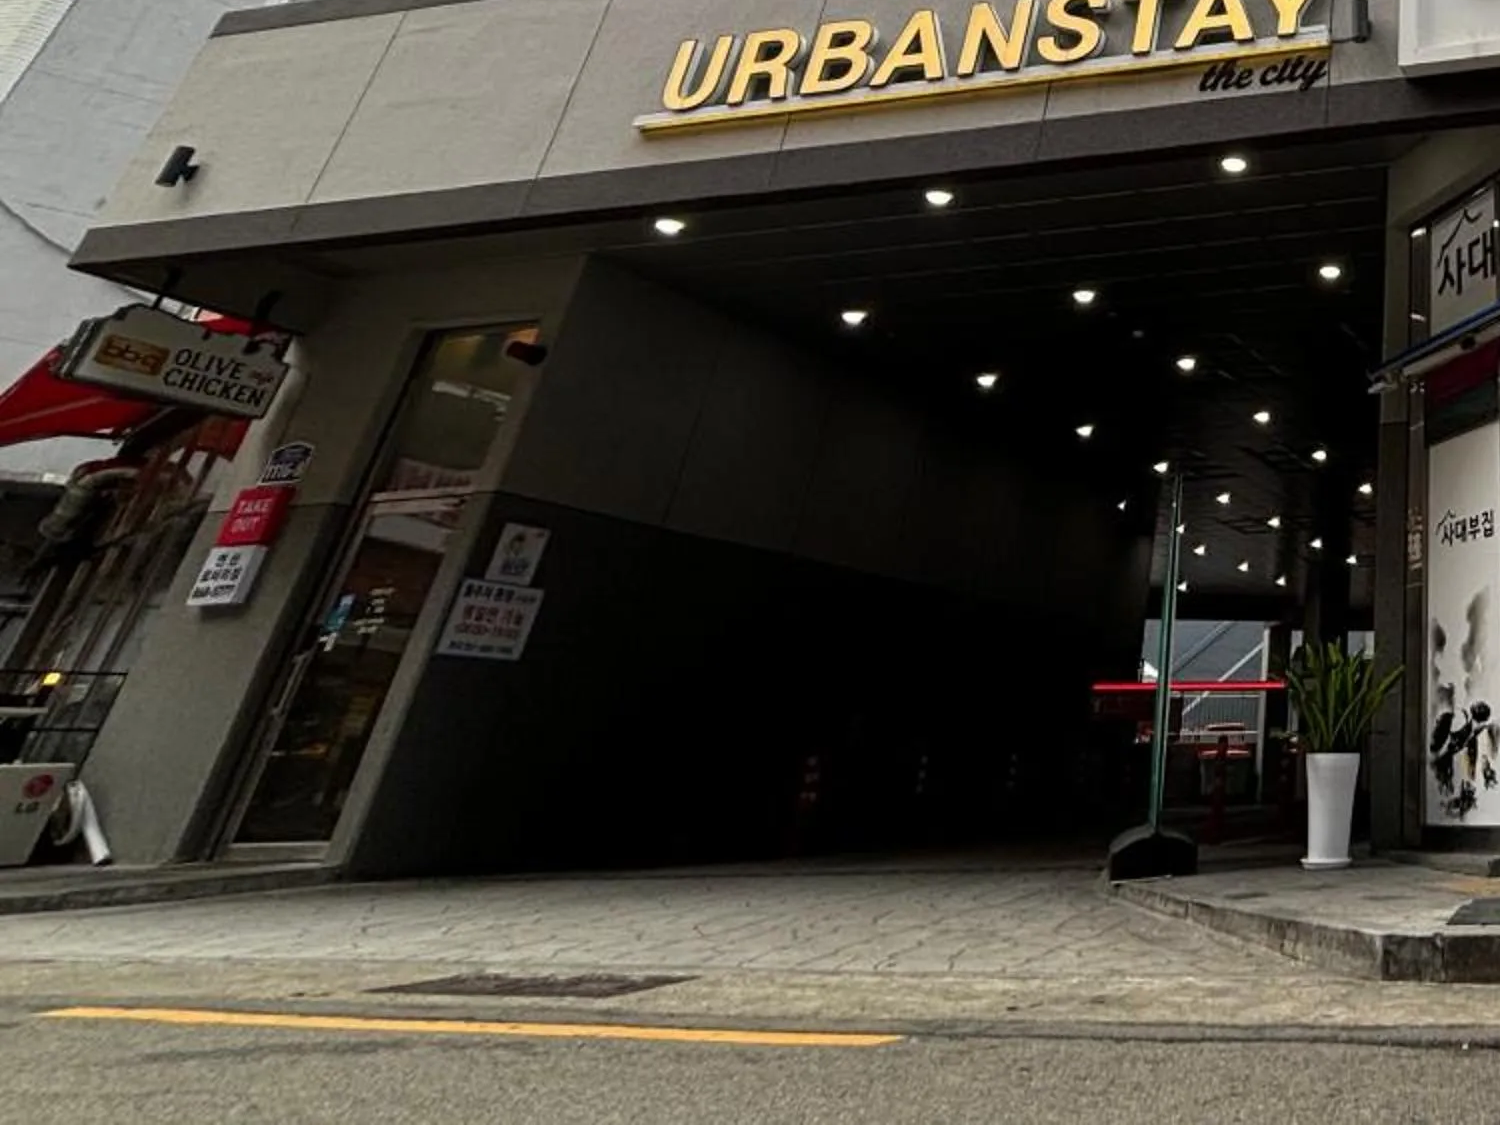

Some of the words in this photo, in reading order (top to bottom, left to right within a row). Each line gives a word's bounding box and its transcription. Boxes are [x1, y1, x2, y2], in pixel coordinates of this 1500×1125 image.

[1199, 58, 1253, 92] the
[1260, 55, 1328, 91] city
[175, 348, 248, 380] OLIVE
[163, 369, 267, 407] CHICKEN
[237, 498, 274, 513] TAKE
[1440, 508, 1495, 546] 사대부집
